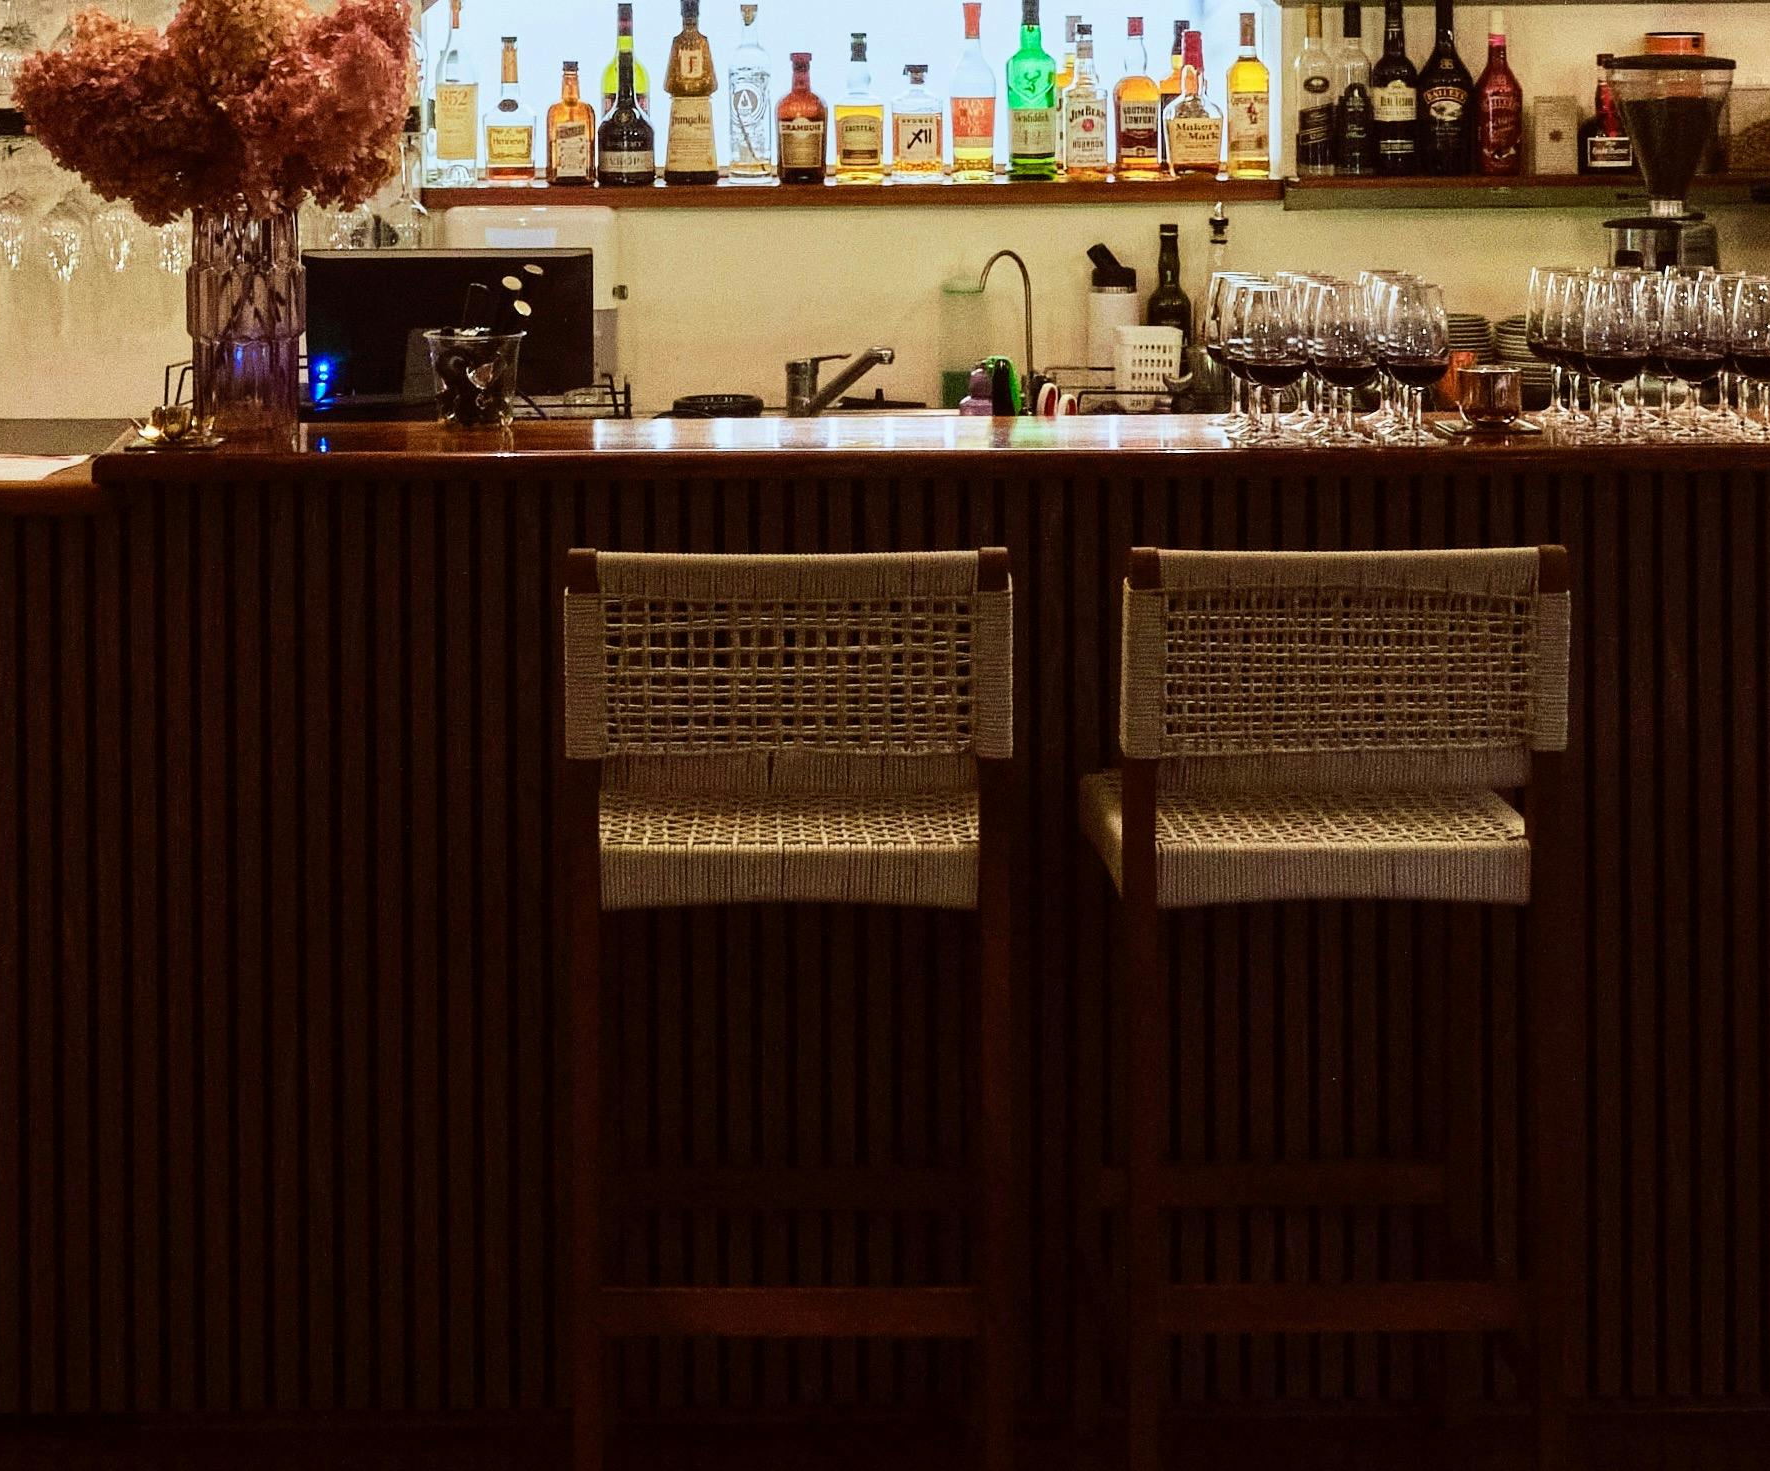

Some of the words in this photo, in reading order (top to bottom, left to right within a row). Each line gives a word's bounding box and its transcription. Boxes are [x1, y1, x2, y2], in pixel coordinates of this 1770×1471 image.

[1424, 87, 1467, 103] BAILEYS
[1176, 123, 1220, 132] Maker's
[1188, 131, 1220, 140] Mark
